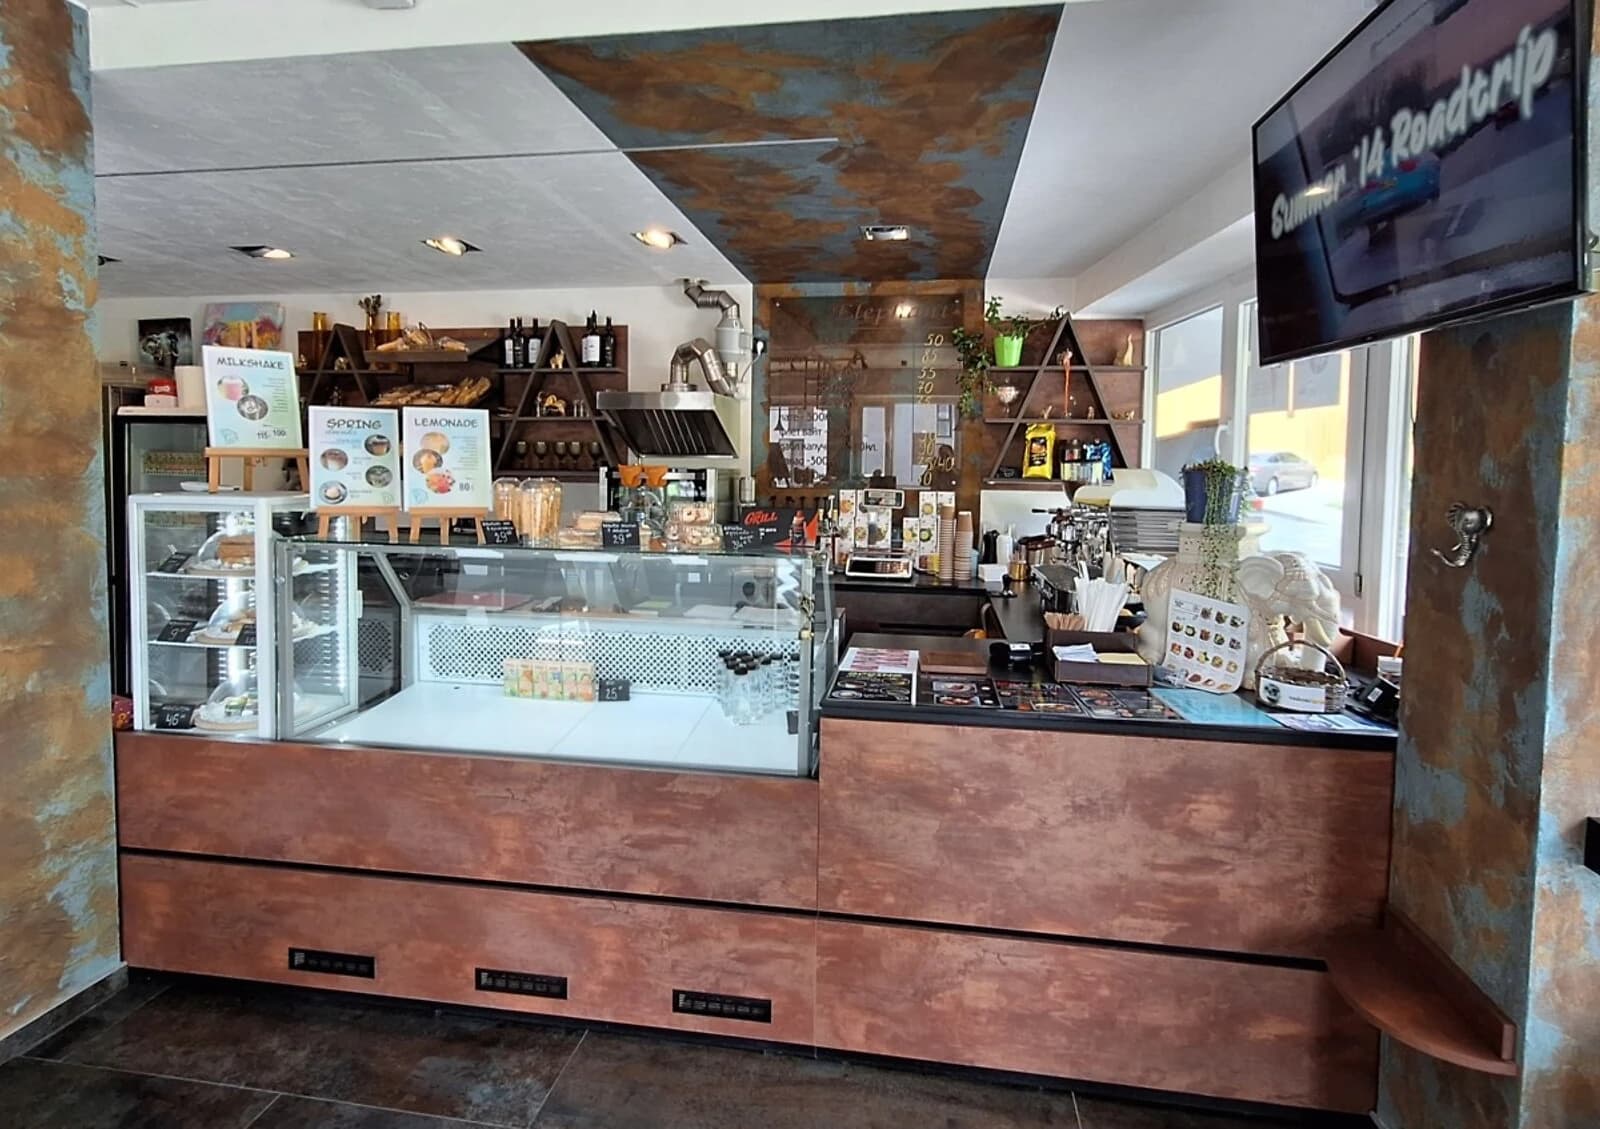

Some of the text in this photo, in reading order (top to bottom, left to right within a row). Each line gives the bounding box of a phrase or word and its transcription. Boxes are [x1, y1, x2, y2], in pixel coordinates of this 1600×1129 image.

[1270, 164, 1347, 240] Summer
[1390, 25, 1557, 164] Roadtrip
[217, 356, 285, 370] MILKSHAKE
[326, 418, 382, 430] SPRING
[414, 417, 479, 429] LEMONADE
